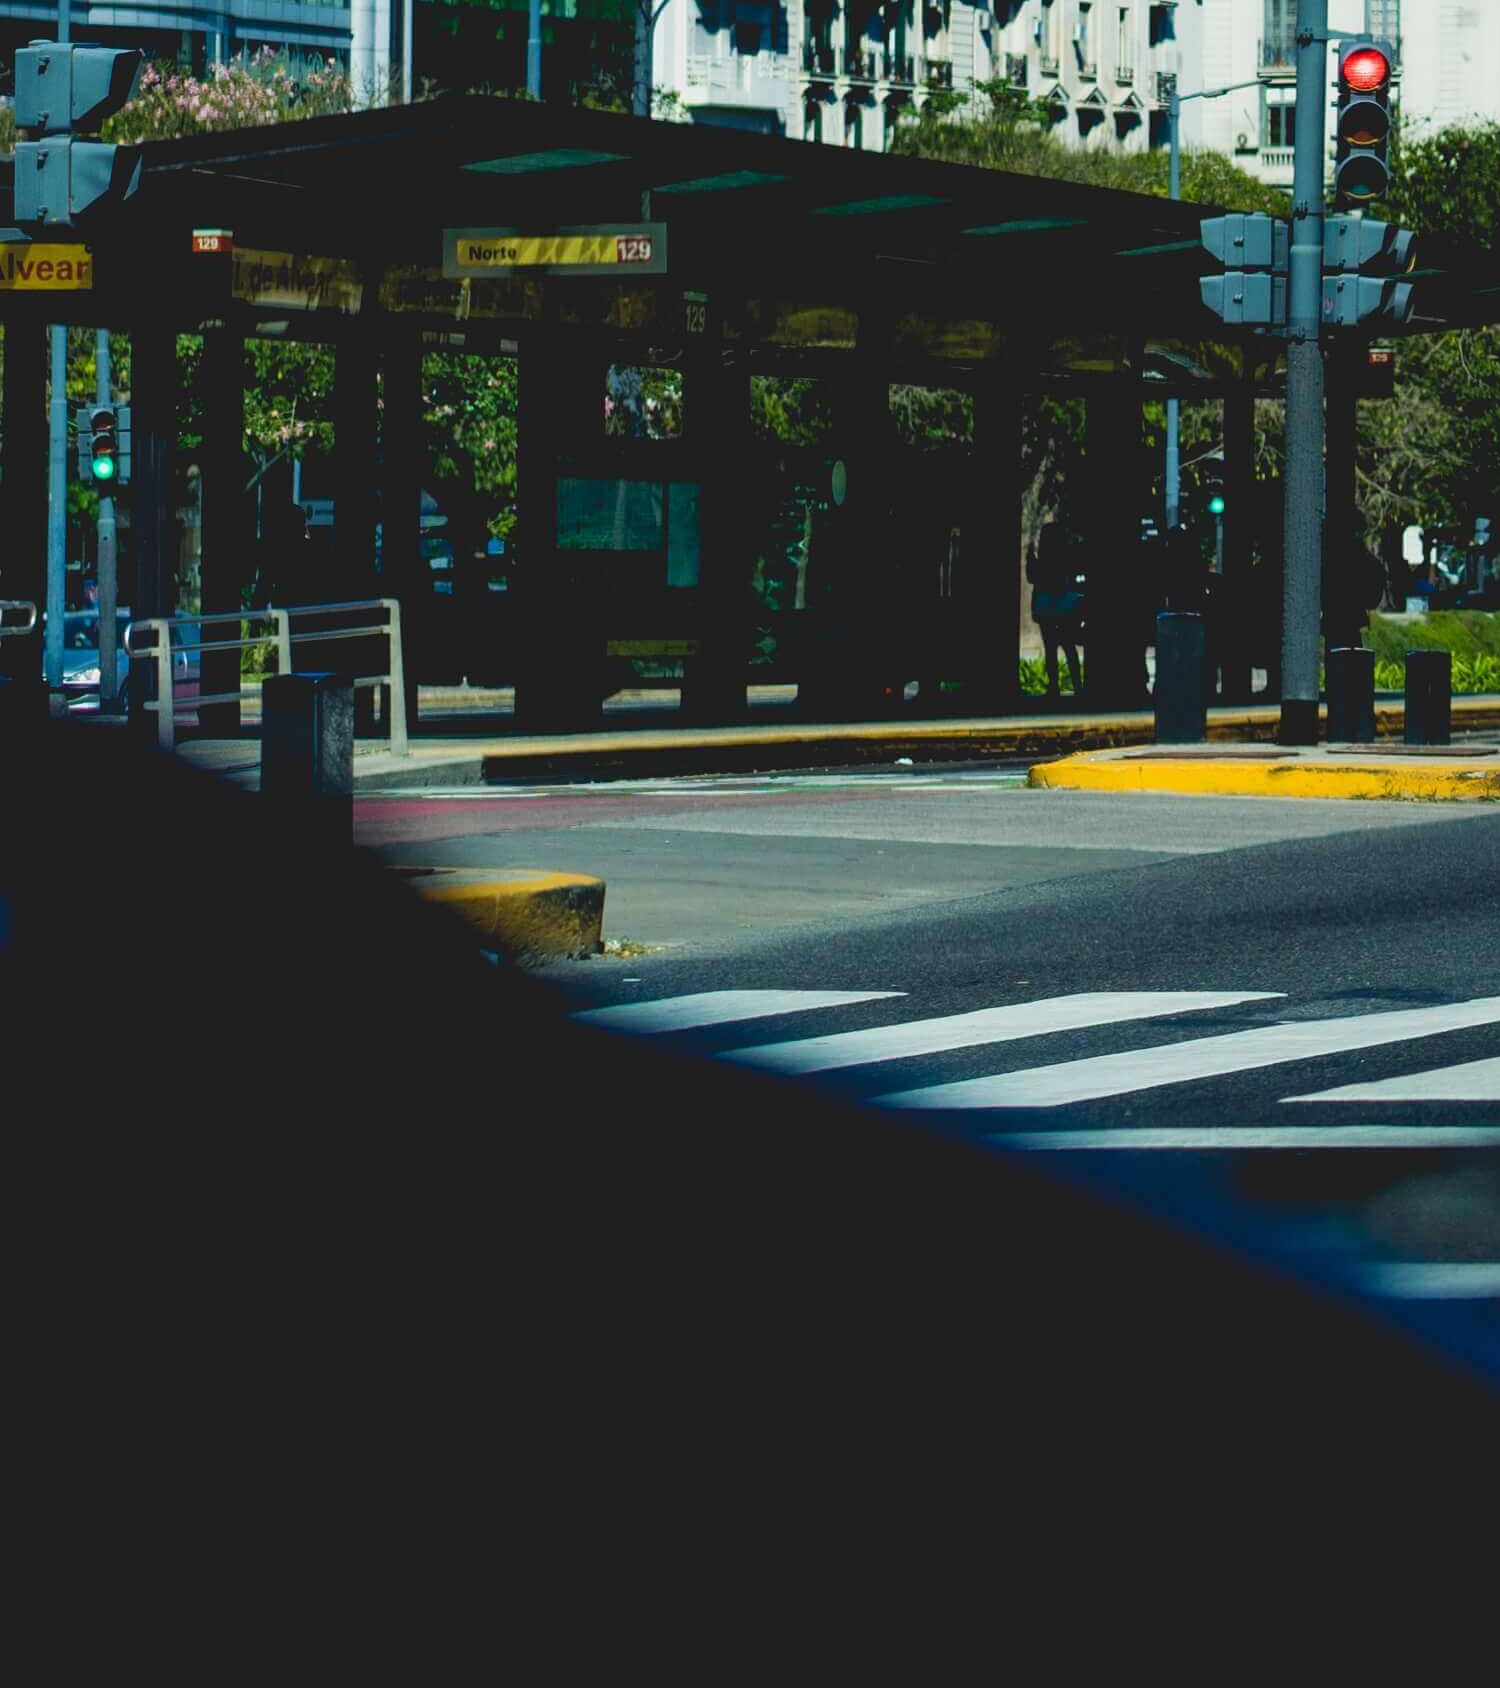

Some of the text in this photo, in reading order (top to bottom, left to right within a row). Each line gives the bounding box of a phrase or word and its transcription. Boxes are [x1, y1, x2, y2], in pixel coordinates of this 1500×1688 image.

[197, 237, 219, 250] 129
[468, 240, 651, 261] Norte 129
[685, 305, 706, 333] 129
